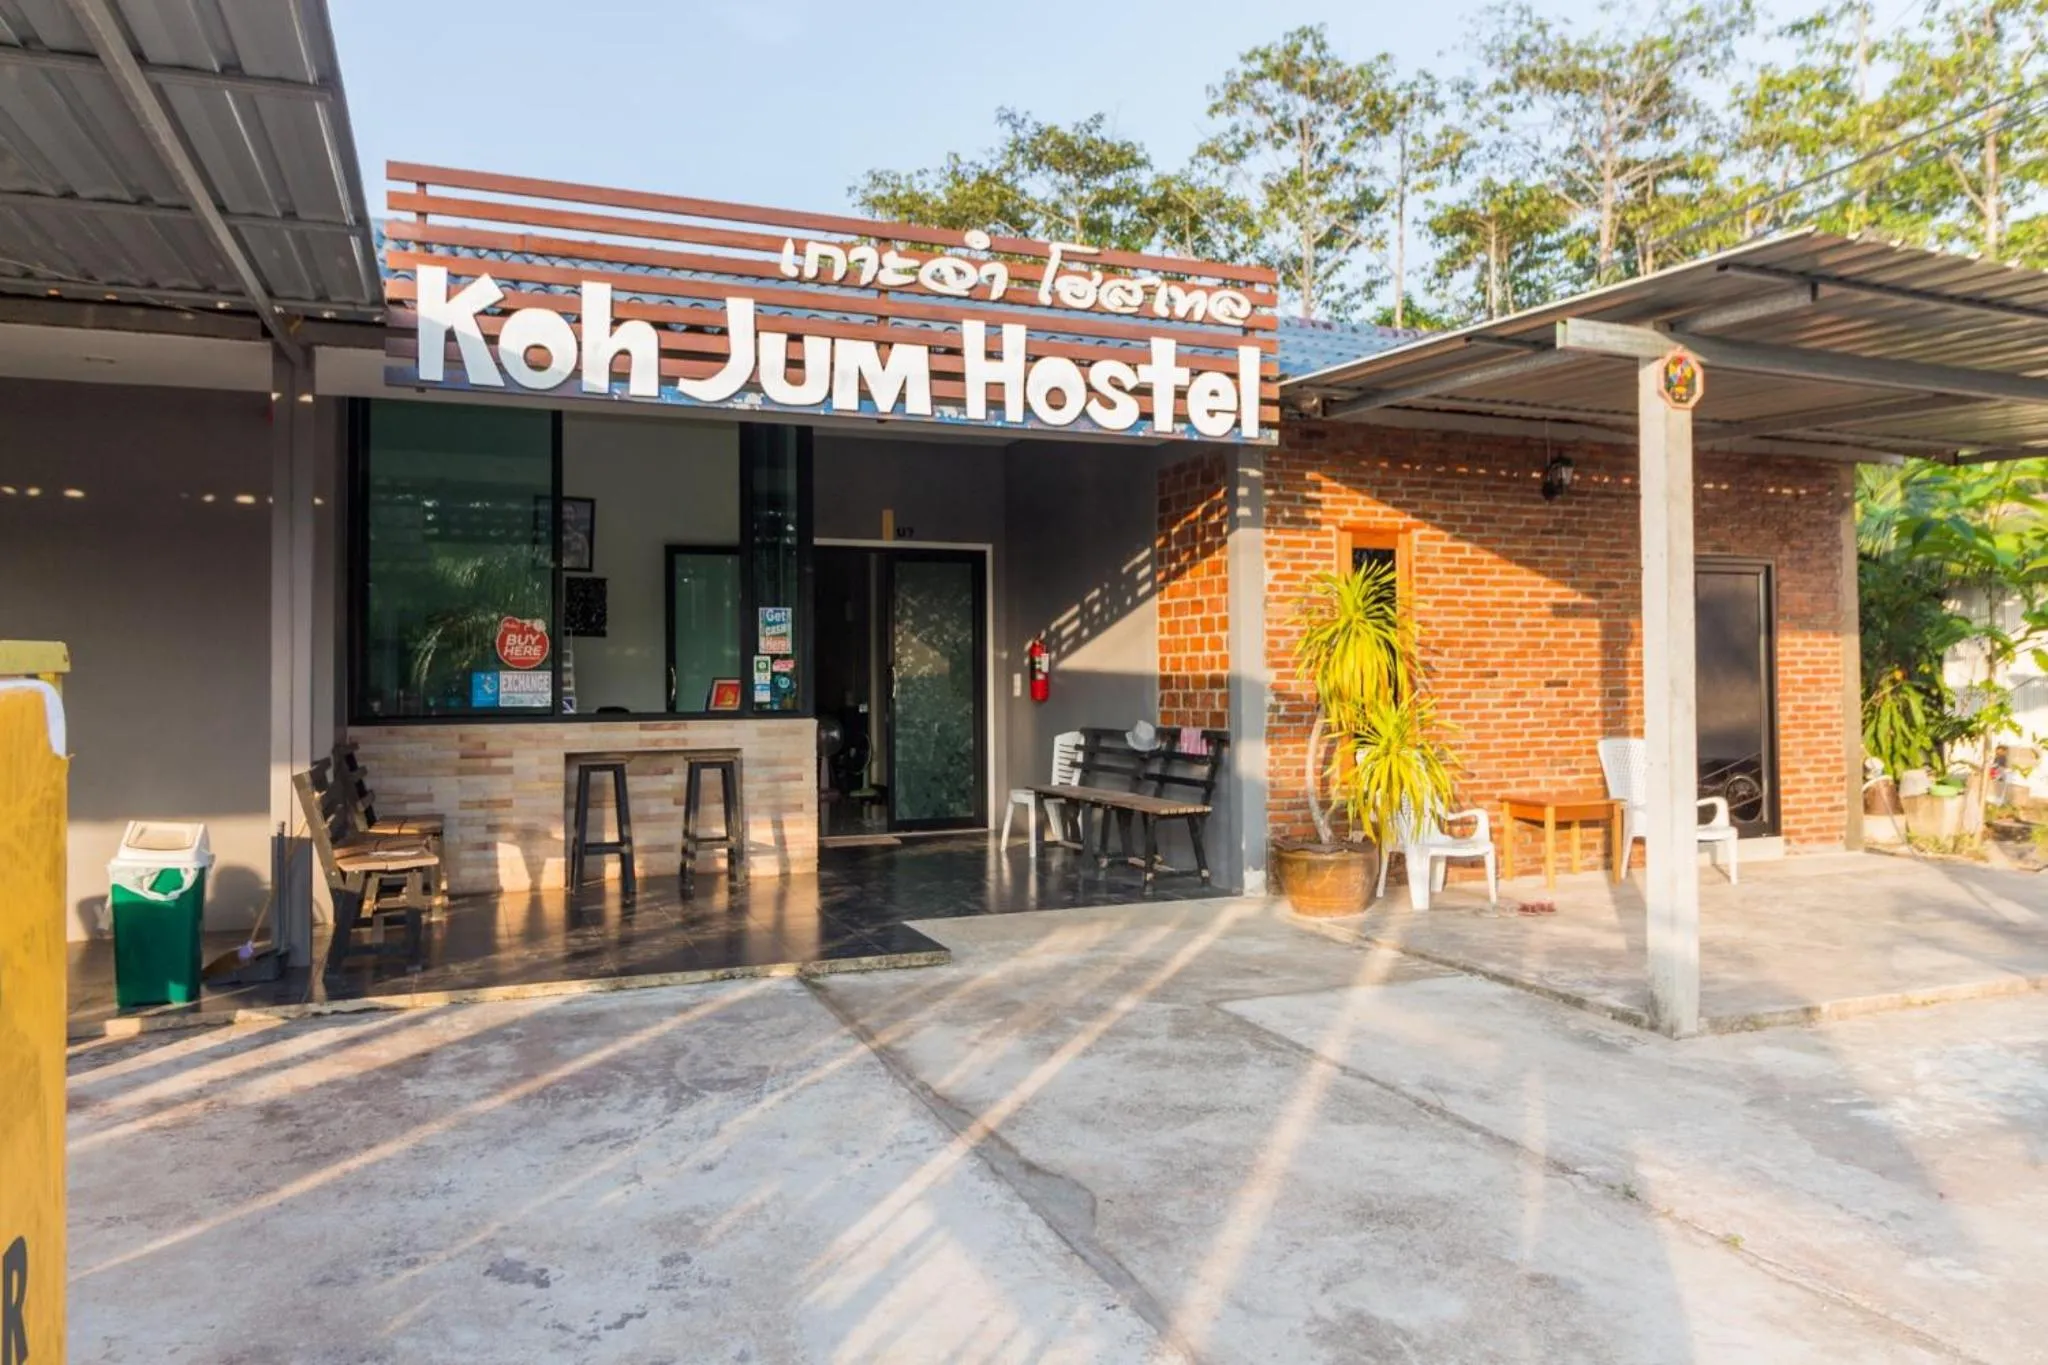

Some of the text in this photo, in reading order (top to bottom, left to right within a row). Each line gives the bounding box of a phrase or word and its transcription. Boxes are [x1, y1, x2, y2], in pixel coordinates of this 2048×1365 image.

[780, 229, 1252, 326] เกาะจำ โฮสเทล
[416, 264, 660, 397] Koh
[962, 319, 1260, 438] Hostel
[766, 609, 786, 621] Get
[507, 634, 541, 646] BUY
[504, 645, 543, 657] HERE
[502, 674, 550, 692] EXCHANGE
